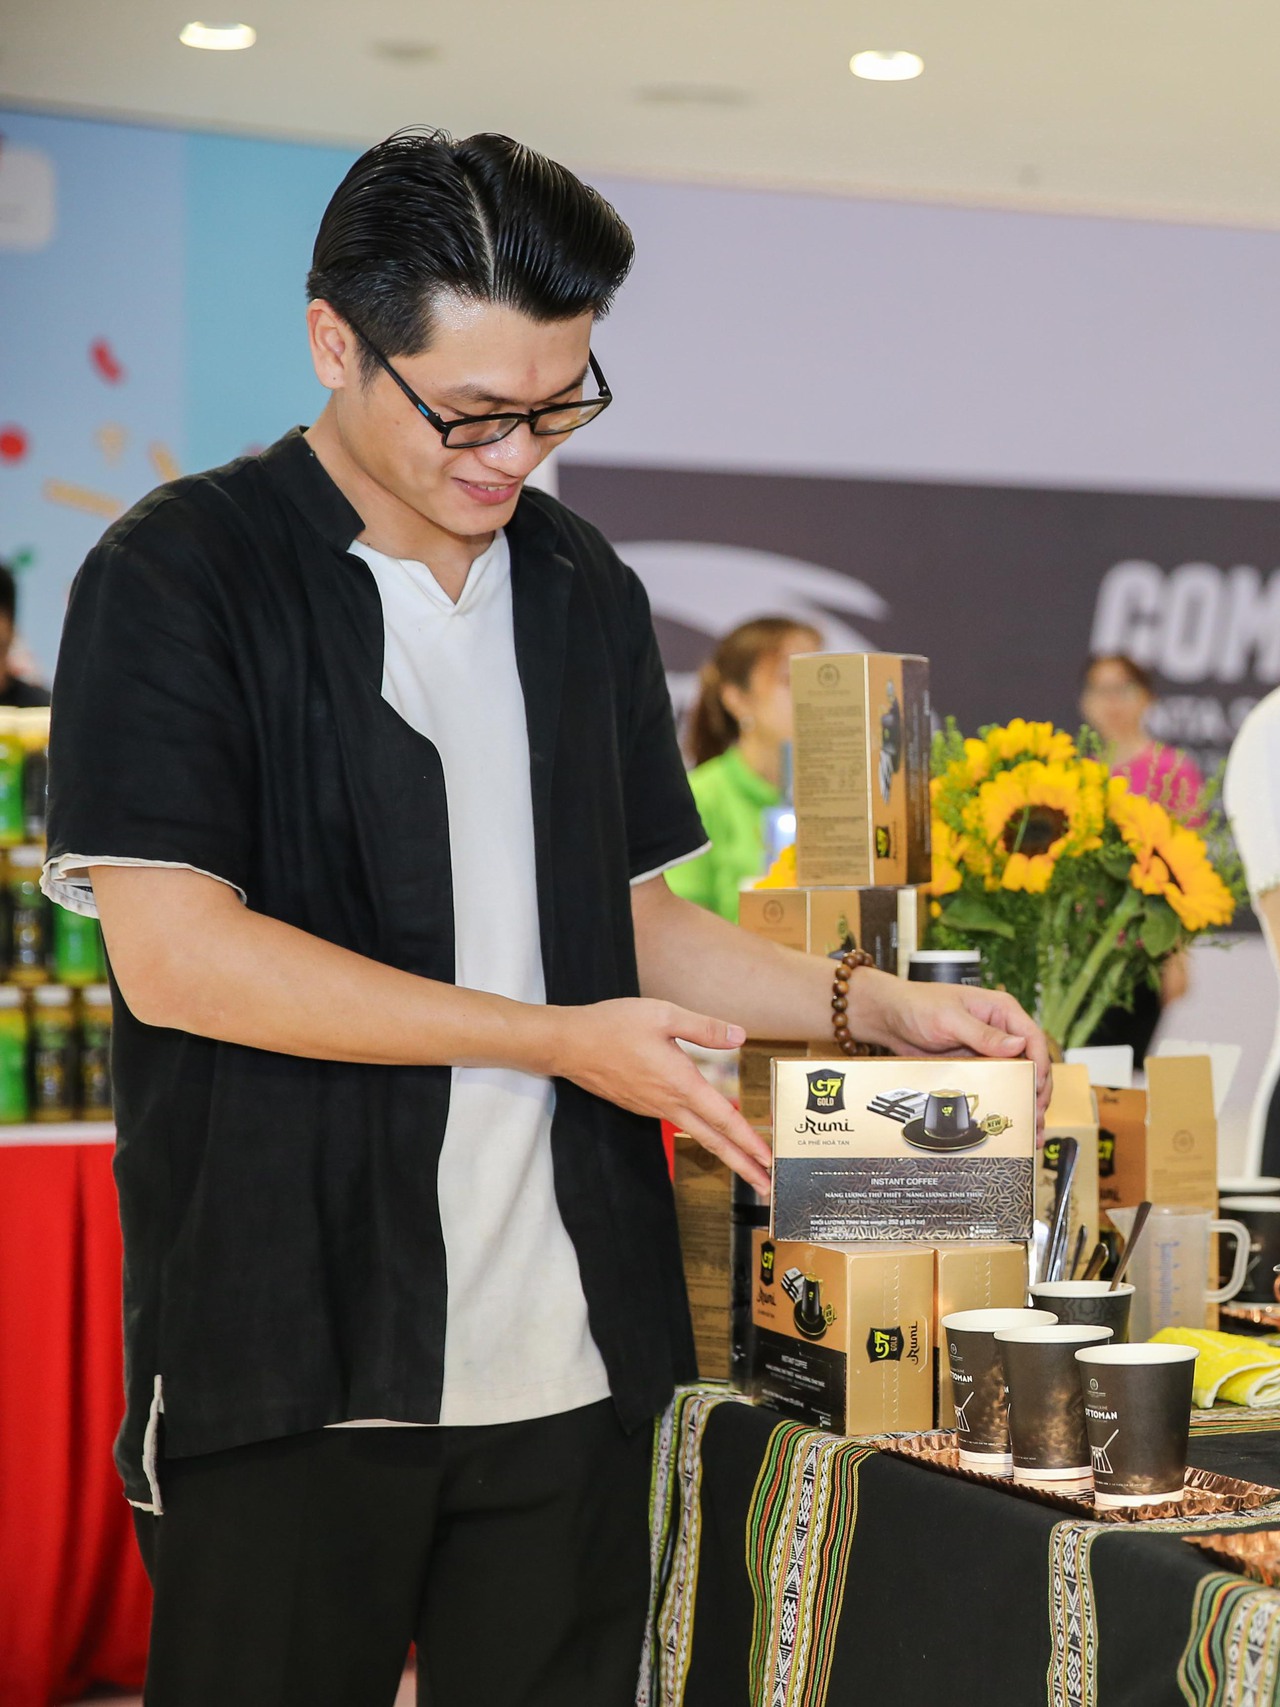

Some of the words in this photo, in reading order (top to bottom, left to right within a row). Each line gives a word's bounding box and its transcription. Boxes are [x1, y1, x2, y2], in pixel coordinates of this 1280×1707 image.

[810, 1077, 842, 1097] G7
[817, 1097, 835, 1107] GOLD
[794, 1115, 855, 1136] Rumi
[987, 1120, 1001, 1128] NEW
[870, 1177, 905, 1186] INSTANT
[906, 1177, 939, 1186] COFFEE
[874, 1331, 890, 1359] G7
[906, 1320, 920, 1366] Rumi
